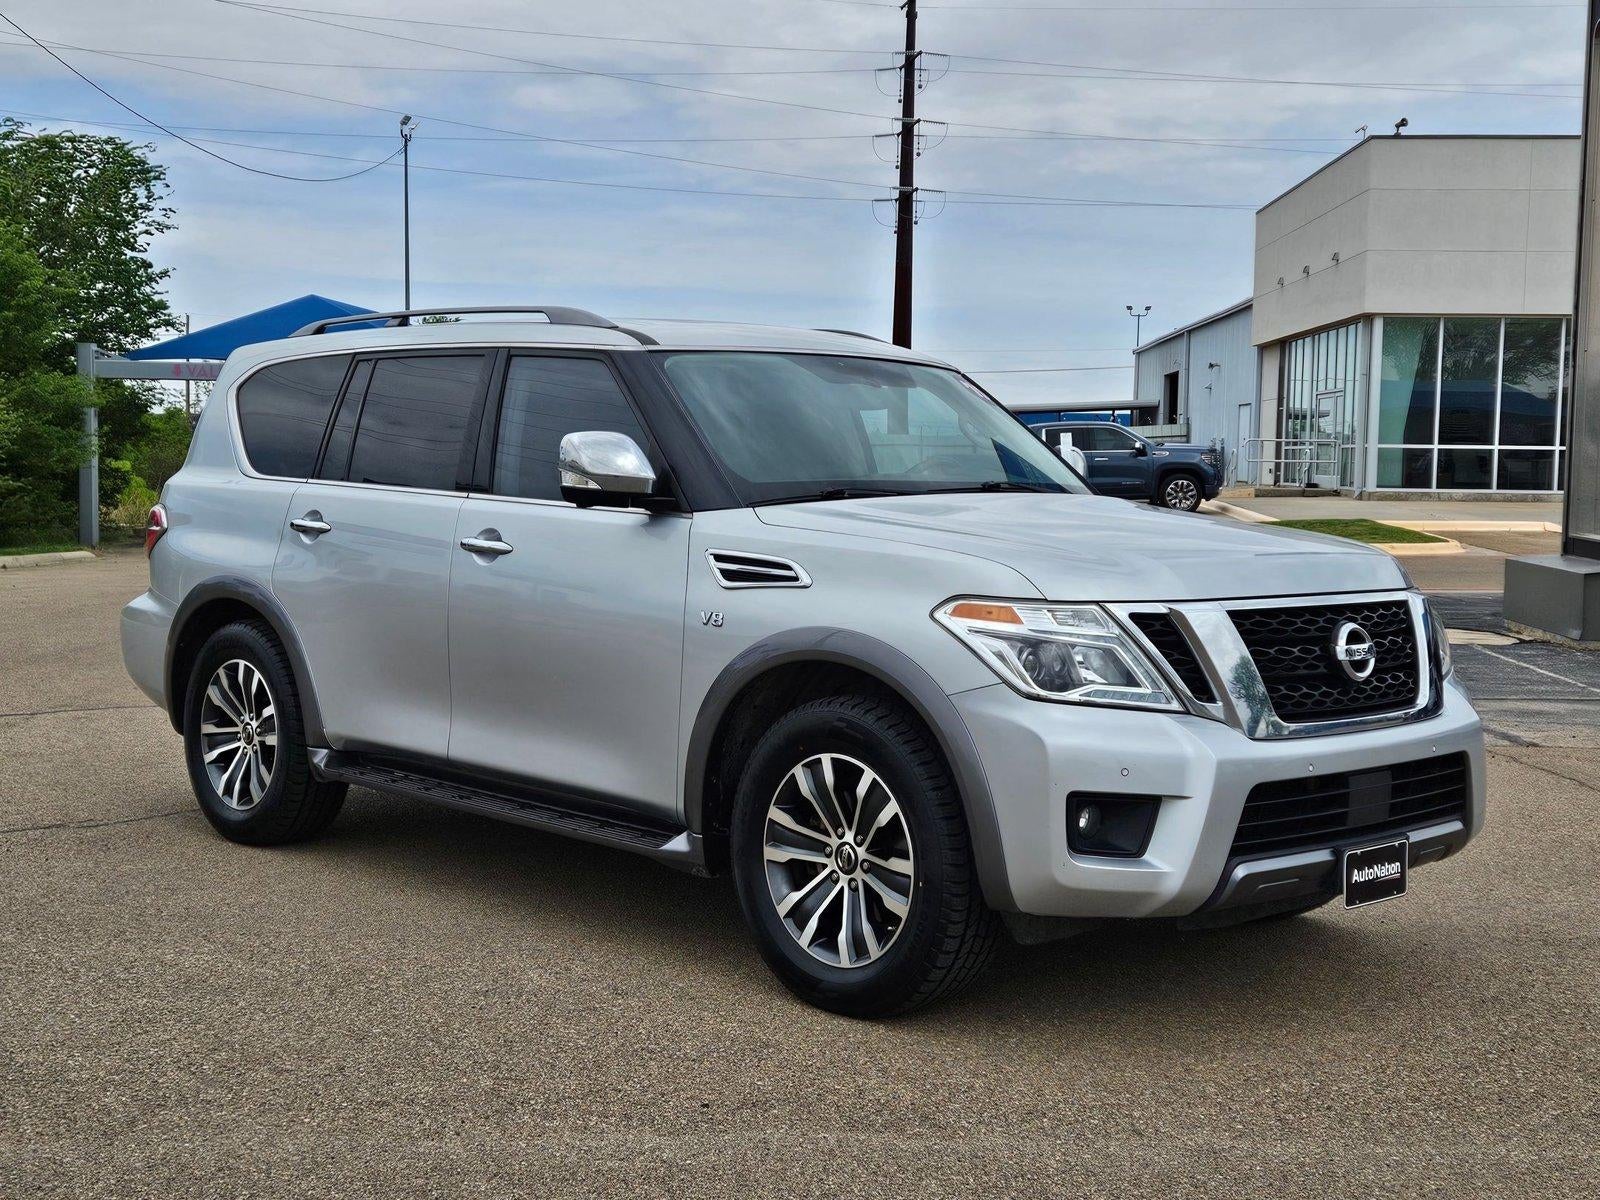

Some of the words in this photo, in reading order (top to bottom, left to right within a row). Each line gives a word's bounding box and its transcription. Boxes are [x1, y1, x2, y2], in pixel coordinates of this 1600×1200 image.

[700, 610, 724, 627] V8
[1345, 646, 1375, 659] NISSA
[1352, 861, 1401, 884] AutoNation
